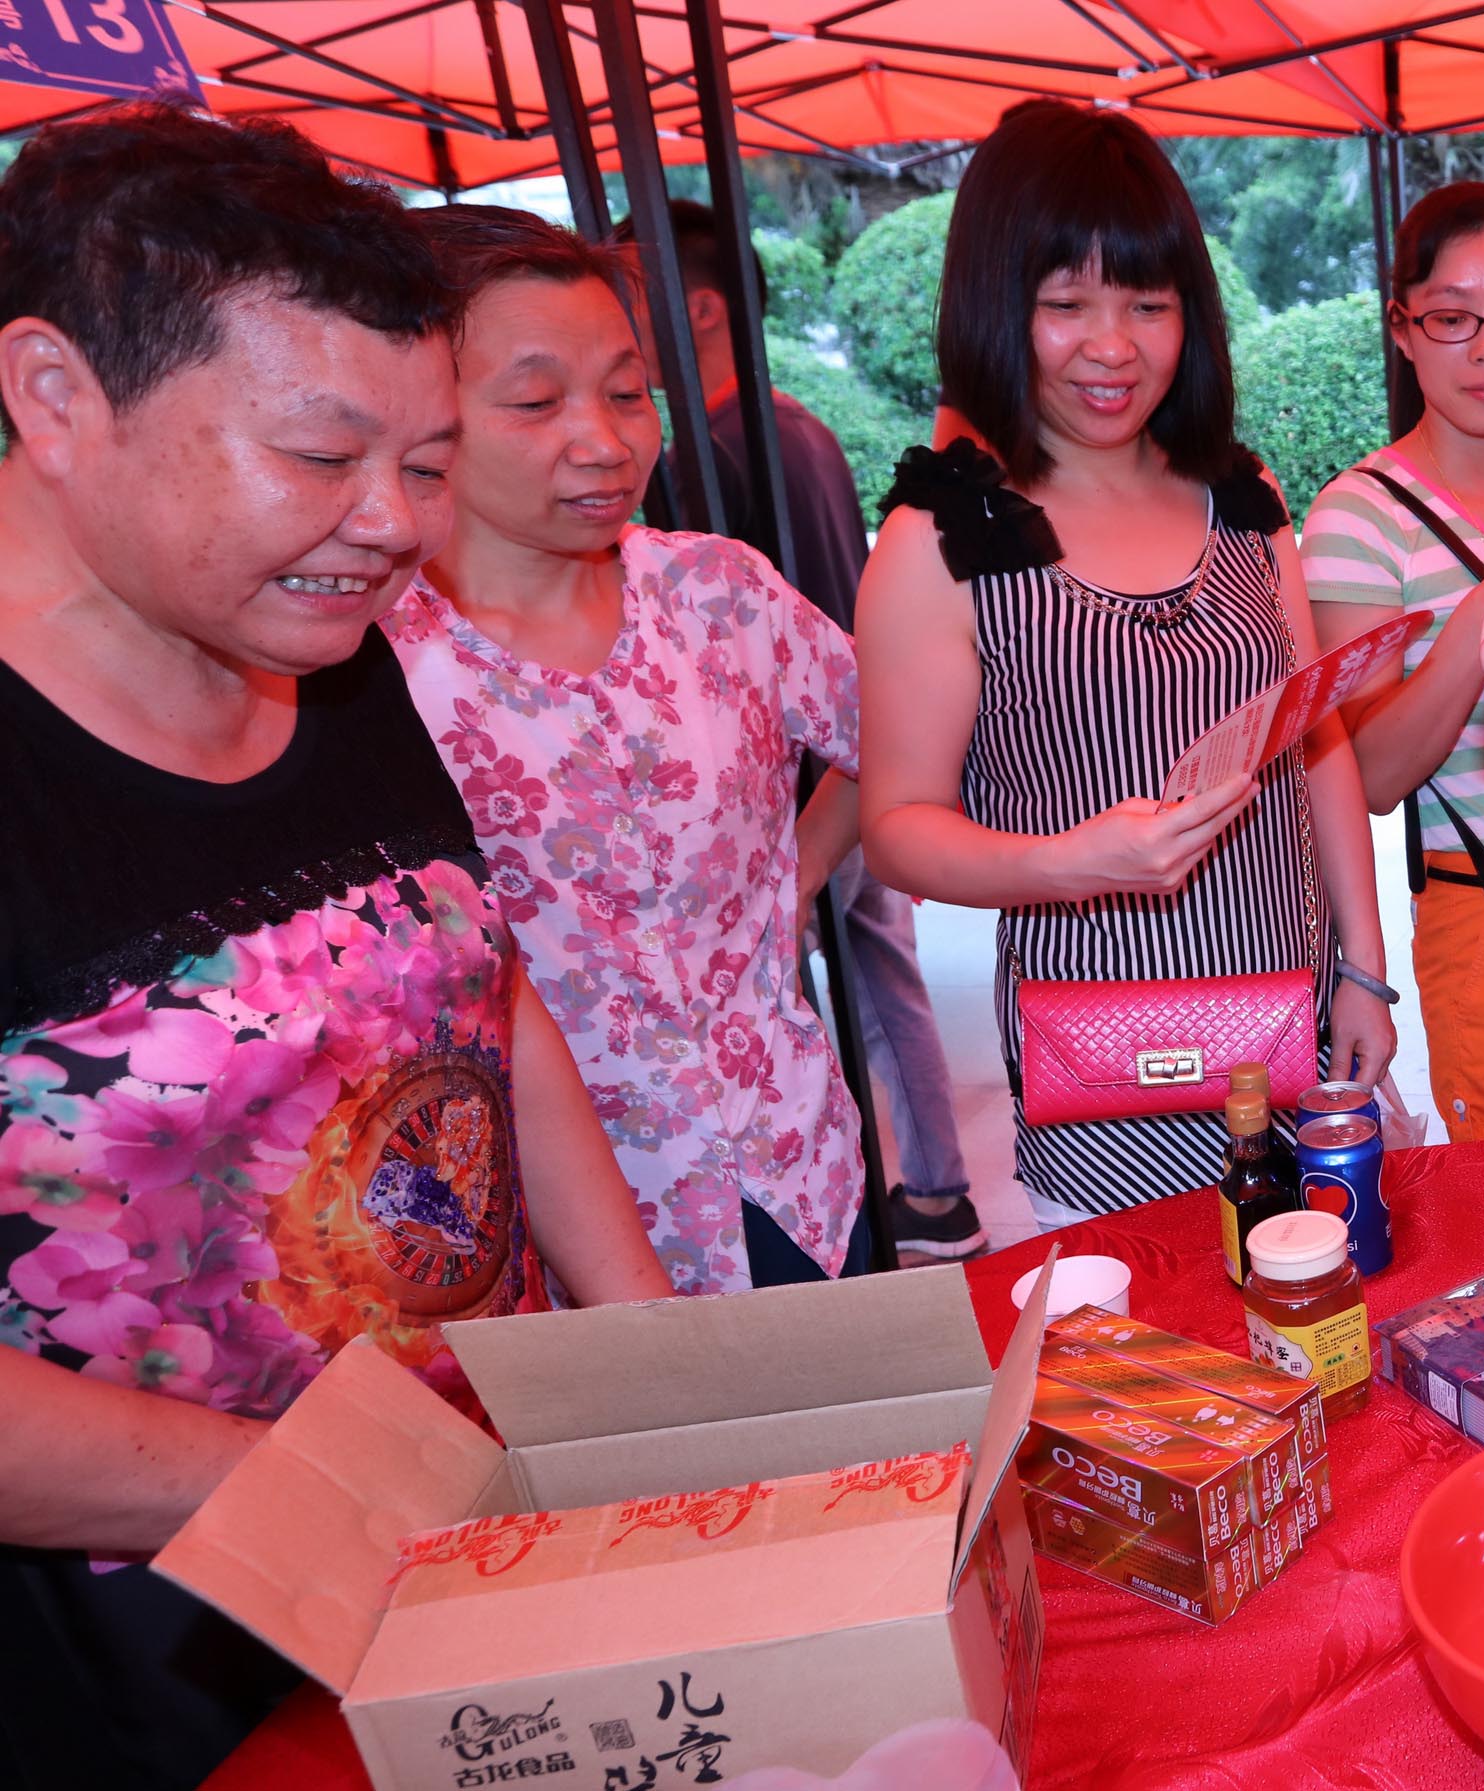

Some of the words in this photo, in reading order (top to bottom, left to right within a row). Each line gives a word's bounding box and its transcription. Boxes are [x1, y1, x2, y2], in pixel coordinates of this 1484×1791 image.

[1247, 1327, 1290, 1361] 杷蜂蜜
[1092, 1410, 1174, 1446] Beco
[1300, 1403, 1313, 1455] Beco
[1052, 1447, 1142, 1503] Beco
[1269, 1451, 1284, 1505] Beco
[1216, 1484, 1232, 1541] Beco
[1304, 1478, 1318, 1528] Beco
[1230, 1544, 1243, 1598] Beco
[656, 1671, 732, 1784] 儿童
[453, 1752, 576, 1789] 古龙食品
